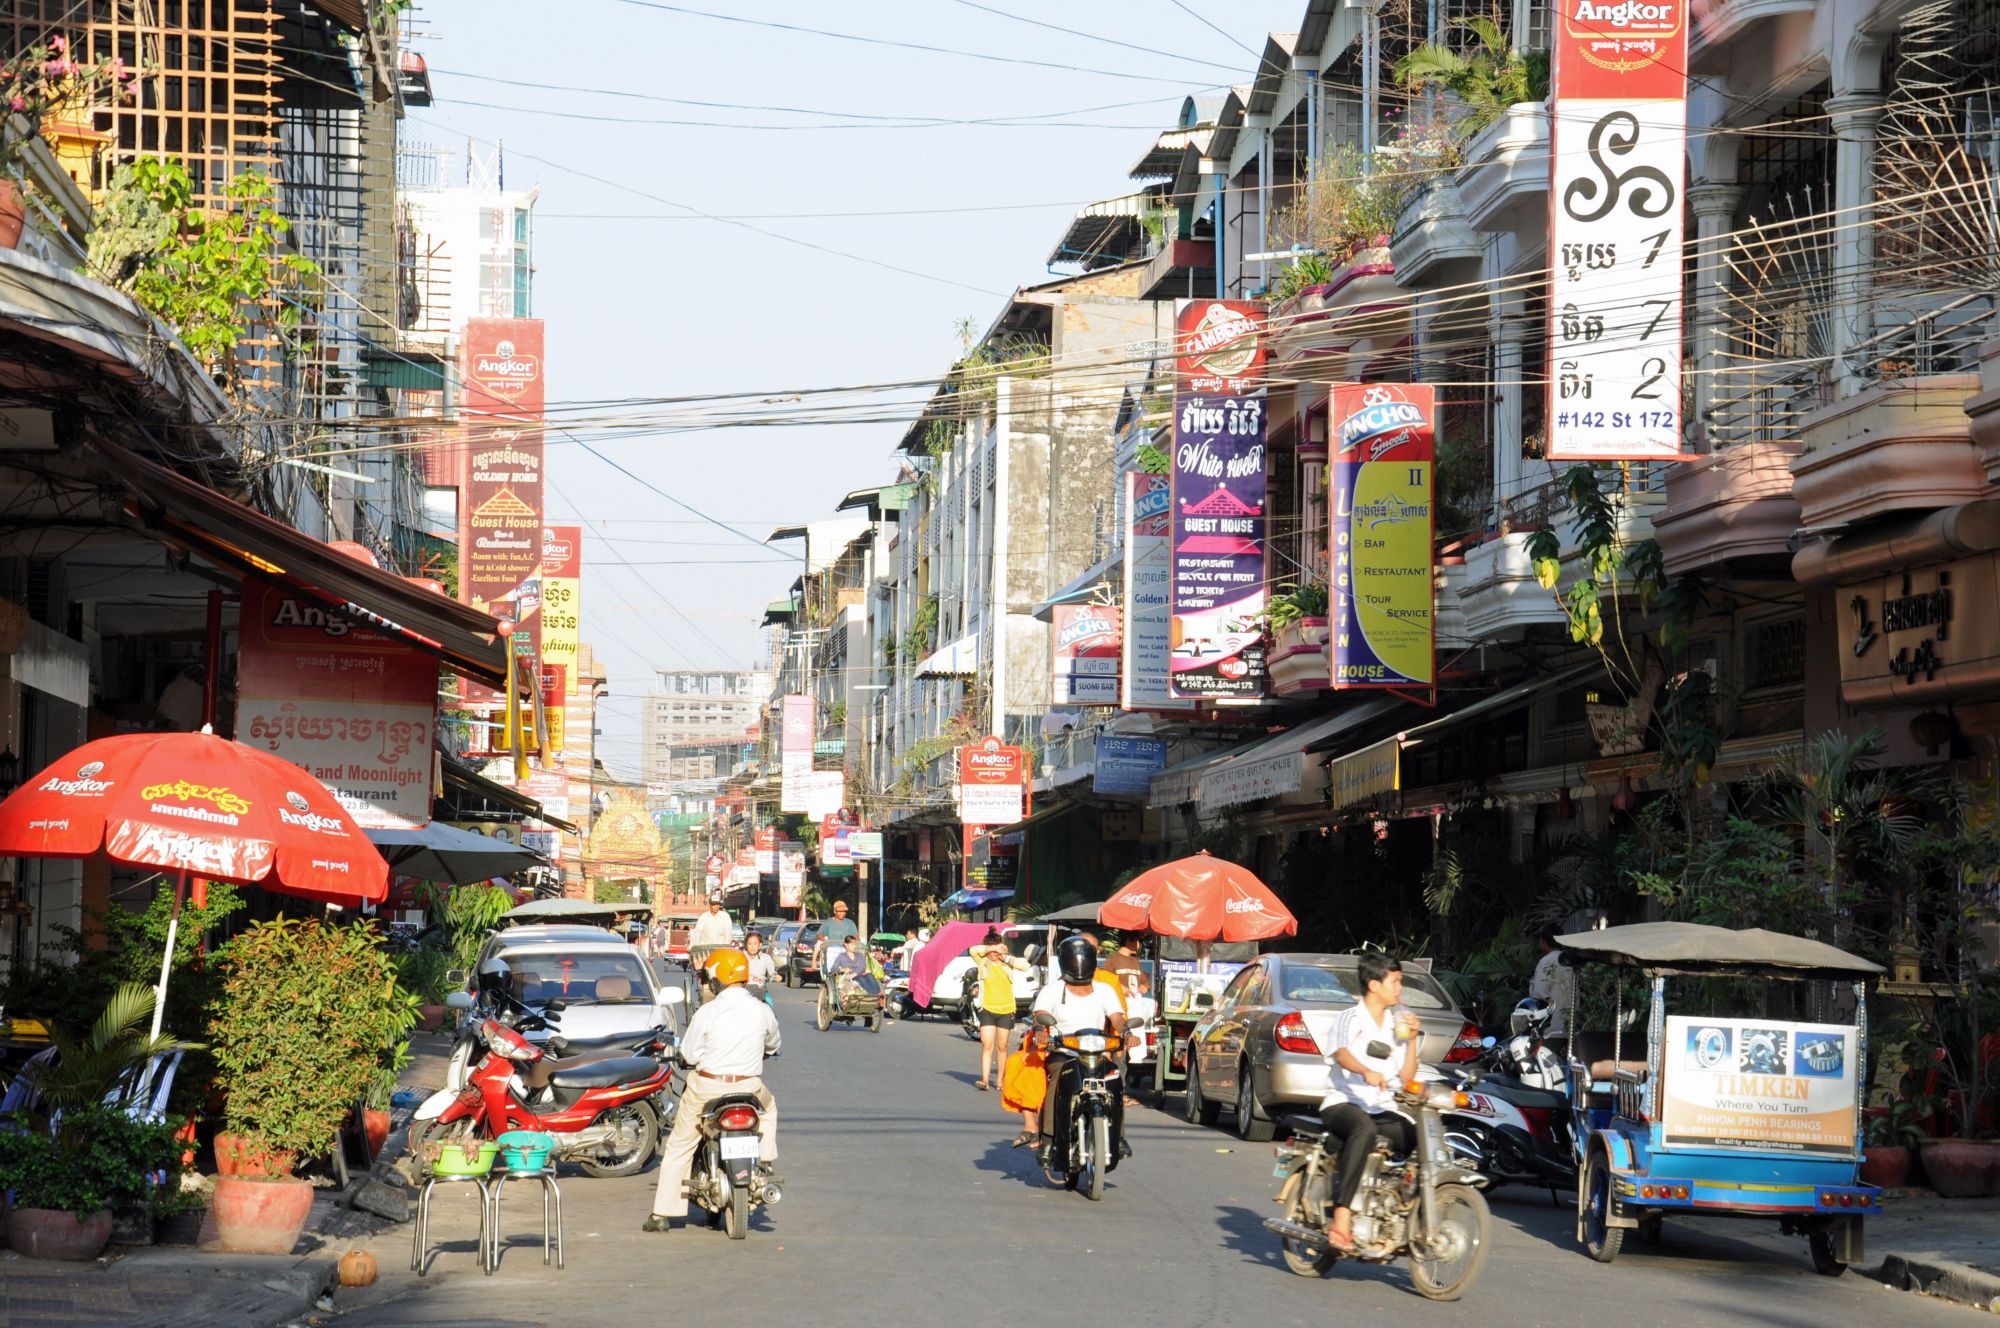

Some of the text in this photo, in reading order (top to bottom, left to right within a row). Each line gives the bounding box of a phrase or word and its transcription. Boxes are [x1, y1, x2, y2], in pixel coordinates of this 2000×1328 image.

[1574, 0, 1673, 27] Angkor
[1639, 300, 1673, 341] 7
[1186, 319, 1260, 357] CAMBODIA
[477, 359, 533, 374] Angkor
[1631, 357, 1666, 400] 2
[1343, 405, 1423, 445] ANCHOR
[1558, 411, 1673, 428] #142 St 172
[1370, 428, 1410, 460] Smooth
[473, 472, 510, 482] GOLDEN
[471, 516, 539, 528] Guest House
[1185, 518, 1218, 532] GUEST
[1221, 519, 1254, 533] HOUSE
[543, 544, 568, 555] gkor
[1135, 593, 1163, 604] Golden
[542, 638, 577, 652] ghing
[1337, 665, 1385, 678] HOUSE
[971, 753, 1011, 766] Angkor
[315, 764, 423, 787] and Moonlight
[38, 777, 114, 795] Angkor
[328, 787, 398, 800] staurant
[279, 808, 342, 831] Angkor
[1226, 897, 1265, 914] Coca-Cola
[1714, 1074, 1810, 1101] TIMKEN
[1715, 1099, 1808, 1113] Where You Turn
[1696, 1114, 1822, 1131] PHNOM PENH BEARINGS
